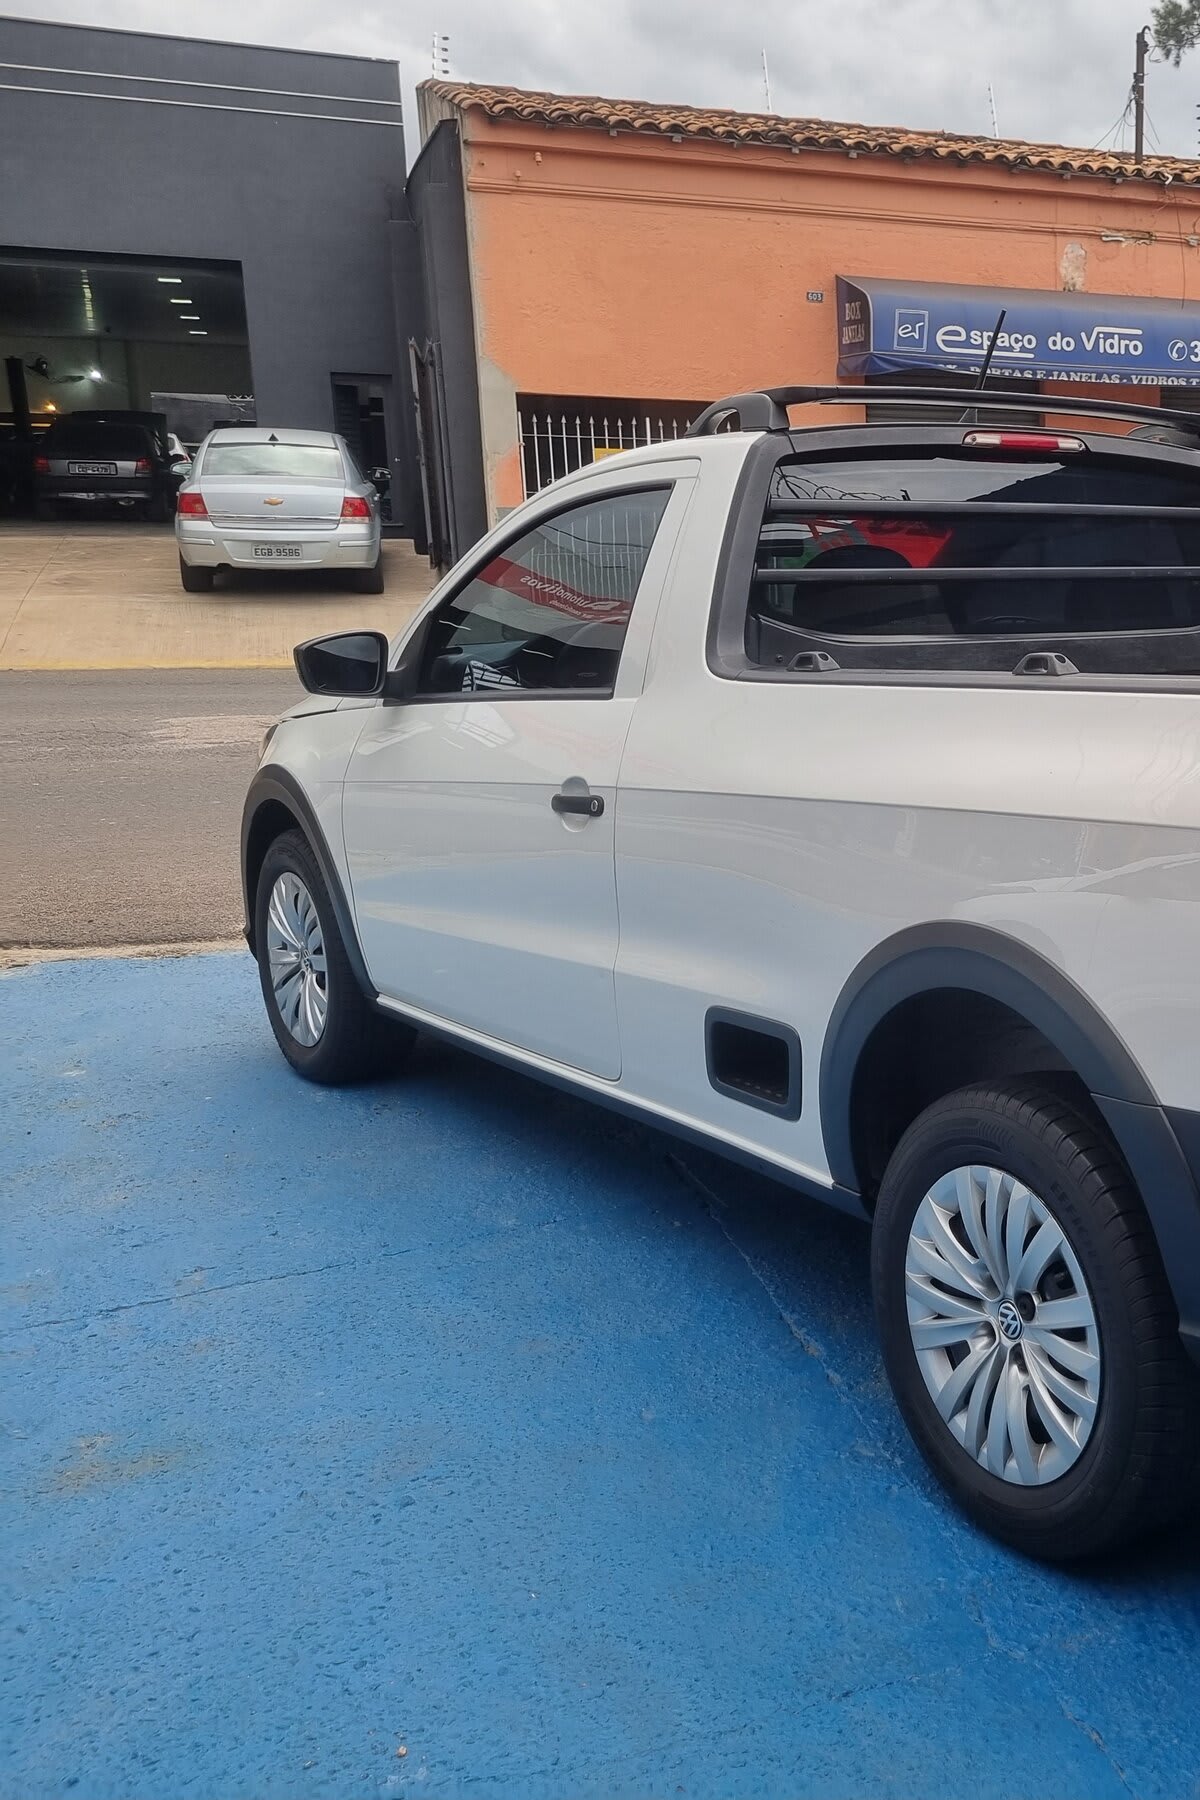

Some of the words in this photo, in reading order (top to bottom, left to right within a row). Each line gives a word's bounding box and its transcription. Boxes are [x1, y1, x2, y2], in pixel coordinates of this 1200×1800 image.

[808, 292, 822, 301] 603
[845, 301, 862, 321] BOX
[842, 324, 865, 345] JANELAS
[1048, 332, 1076, 351] do
[1081, 326, 1143, 356] Vidro
[1048, 371, 1120, 384] JANELAS
[1131, 375, 1187, 386] VIDROS
